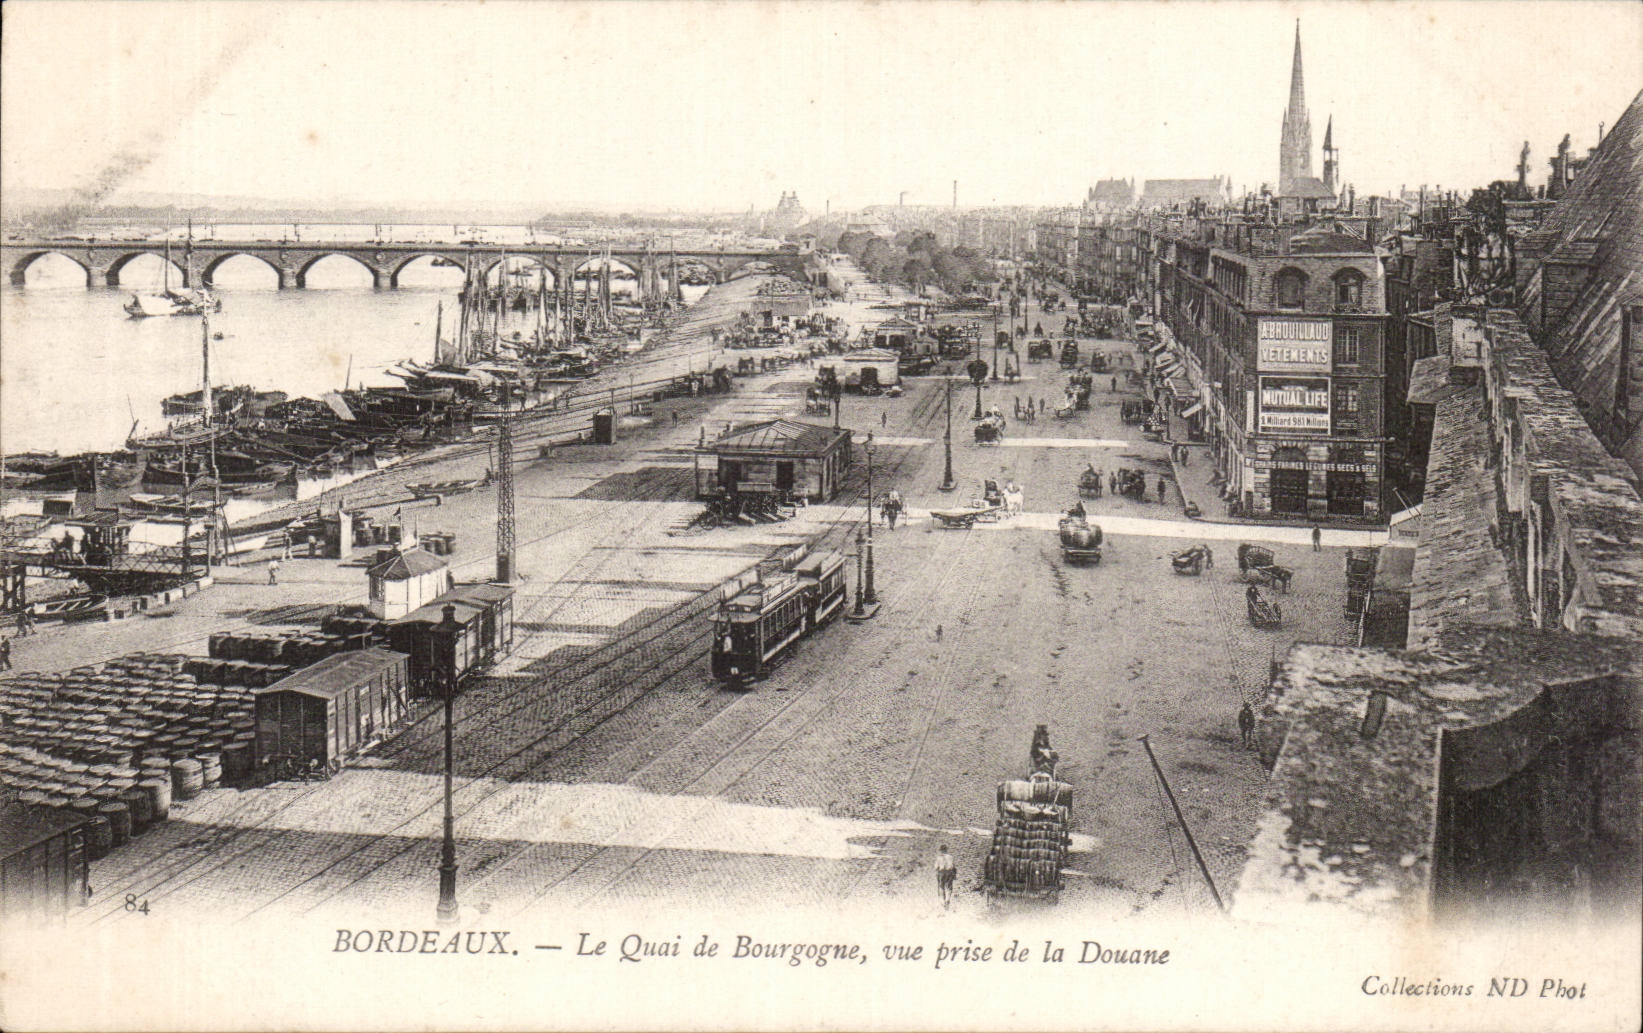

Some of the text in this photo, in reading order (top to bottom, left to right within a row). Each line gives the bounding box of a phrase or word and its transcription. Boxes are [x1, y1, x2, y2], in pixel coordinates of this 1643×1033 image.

[1262, 389, 1328, 409] MUTUAL LIFE
[1267, 415, 1291, 427] Milliard
[1306, 417, 1329, 427] Millions
